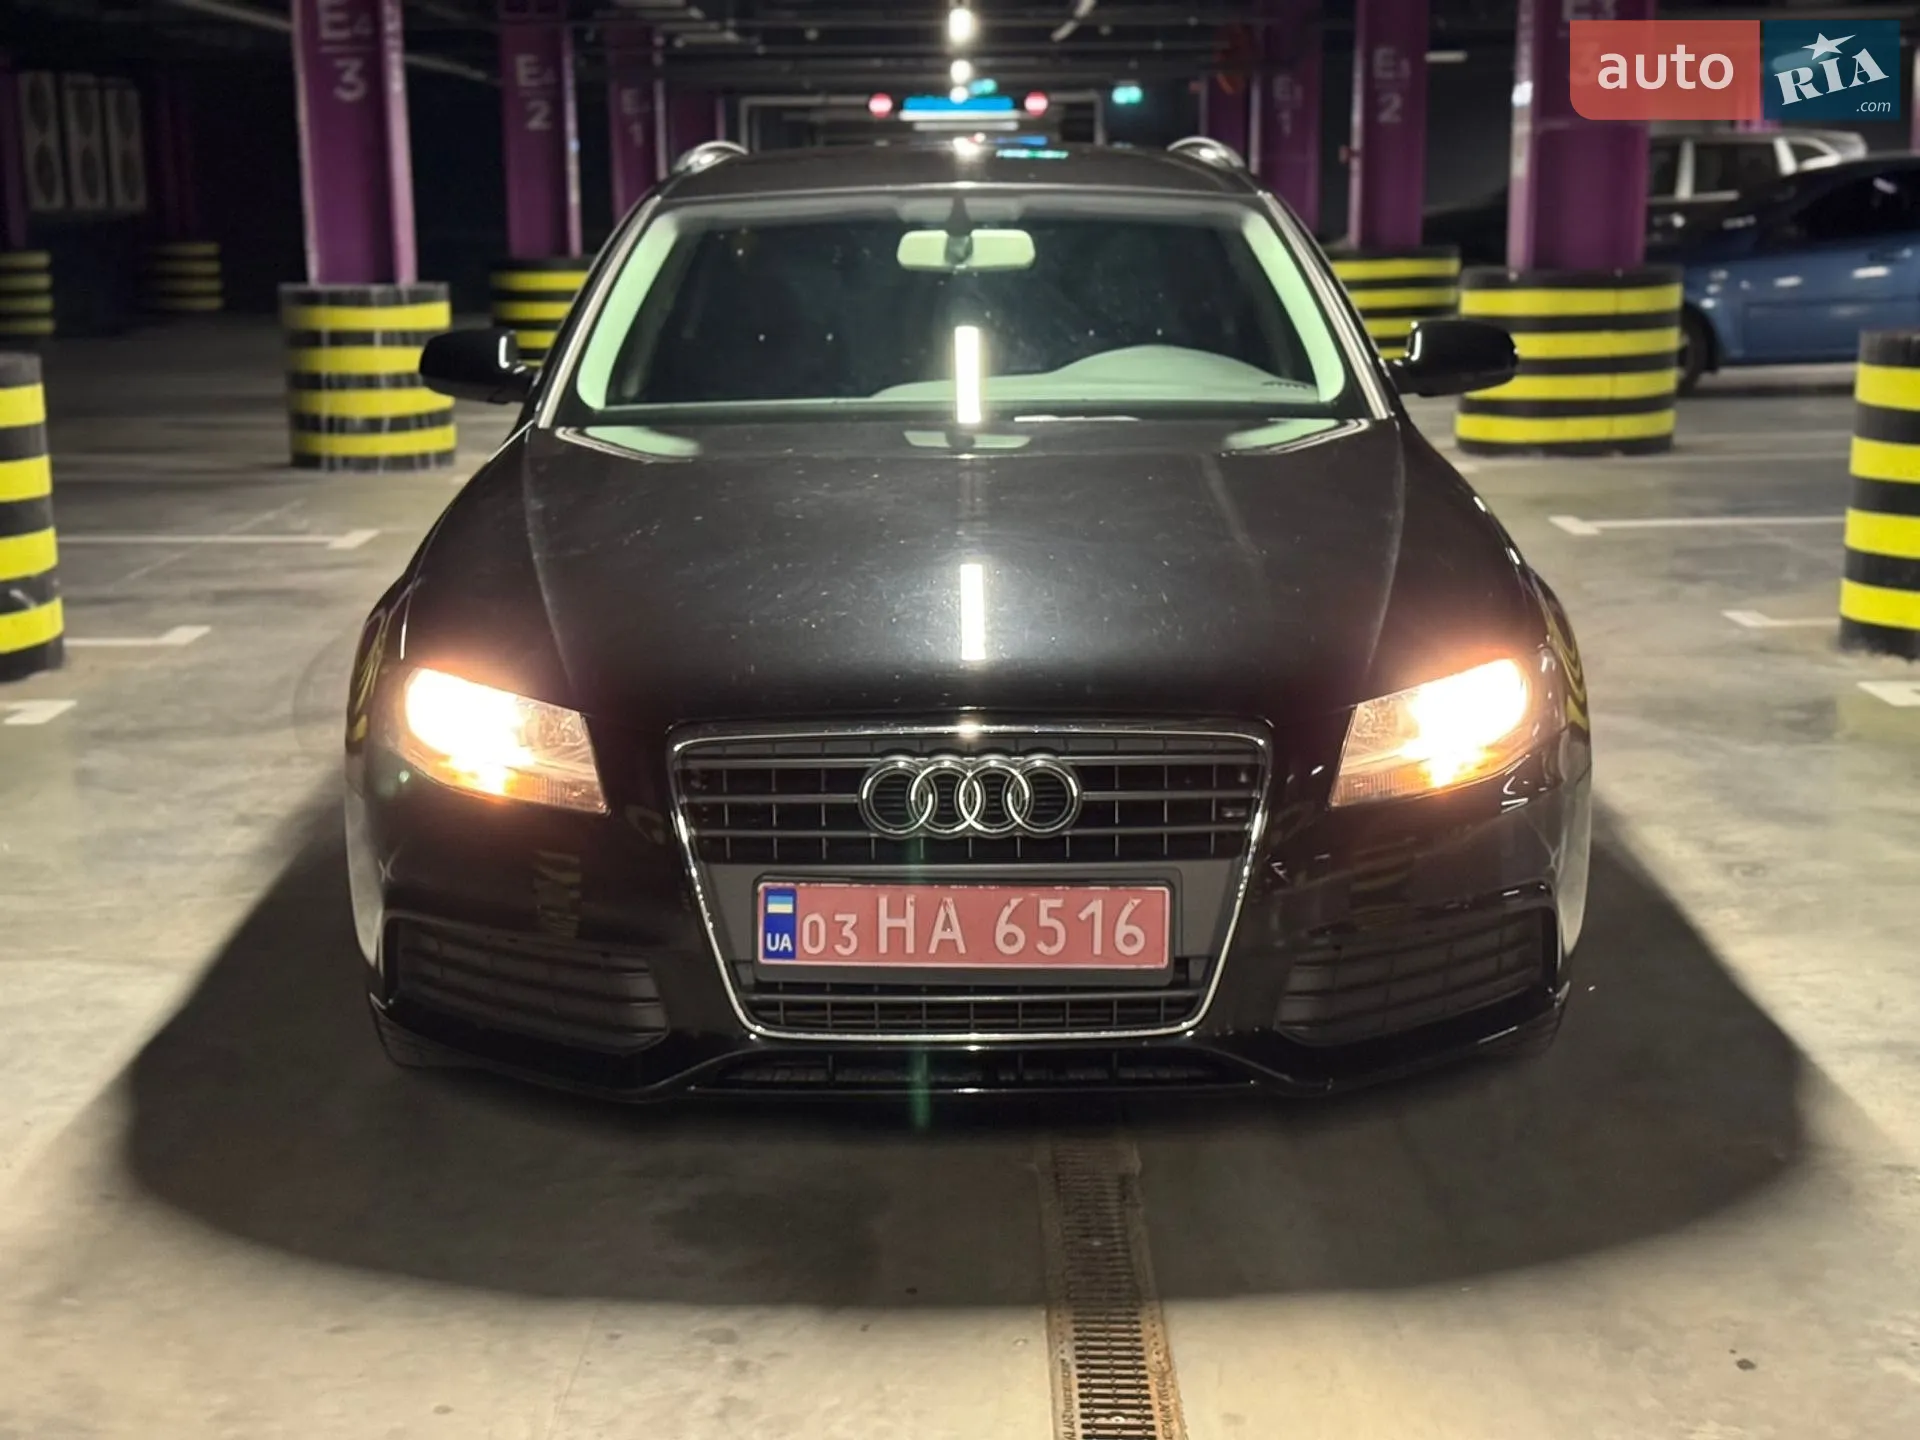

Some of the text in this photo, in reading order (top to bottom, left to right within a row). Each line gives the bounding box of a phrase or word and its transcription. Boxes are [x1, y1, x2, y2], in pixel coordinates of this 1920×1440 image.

[333, 57, 366, 101] 3
[525, 99, 551, 131] 2
[1378, 93, 1402, 124] 2
[802, 894, 1146, 956] 03 HA 6516
[766, 932, 793, 952] UA
